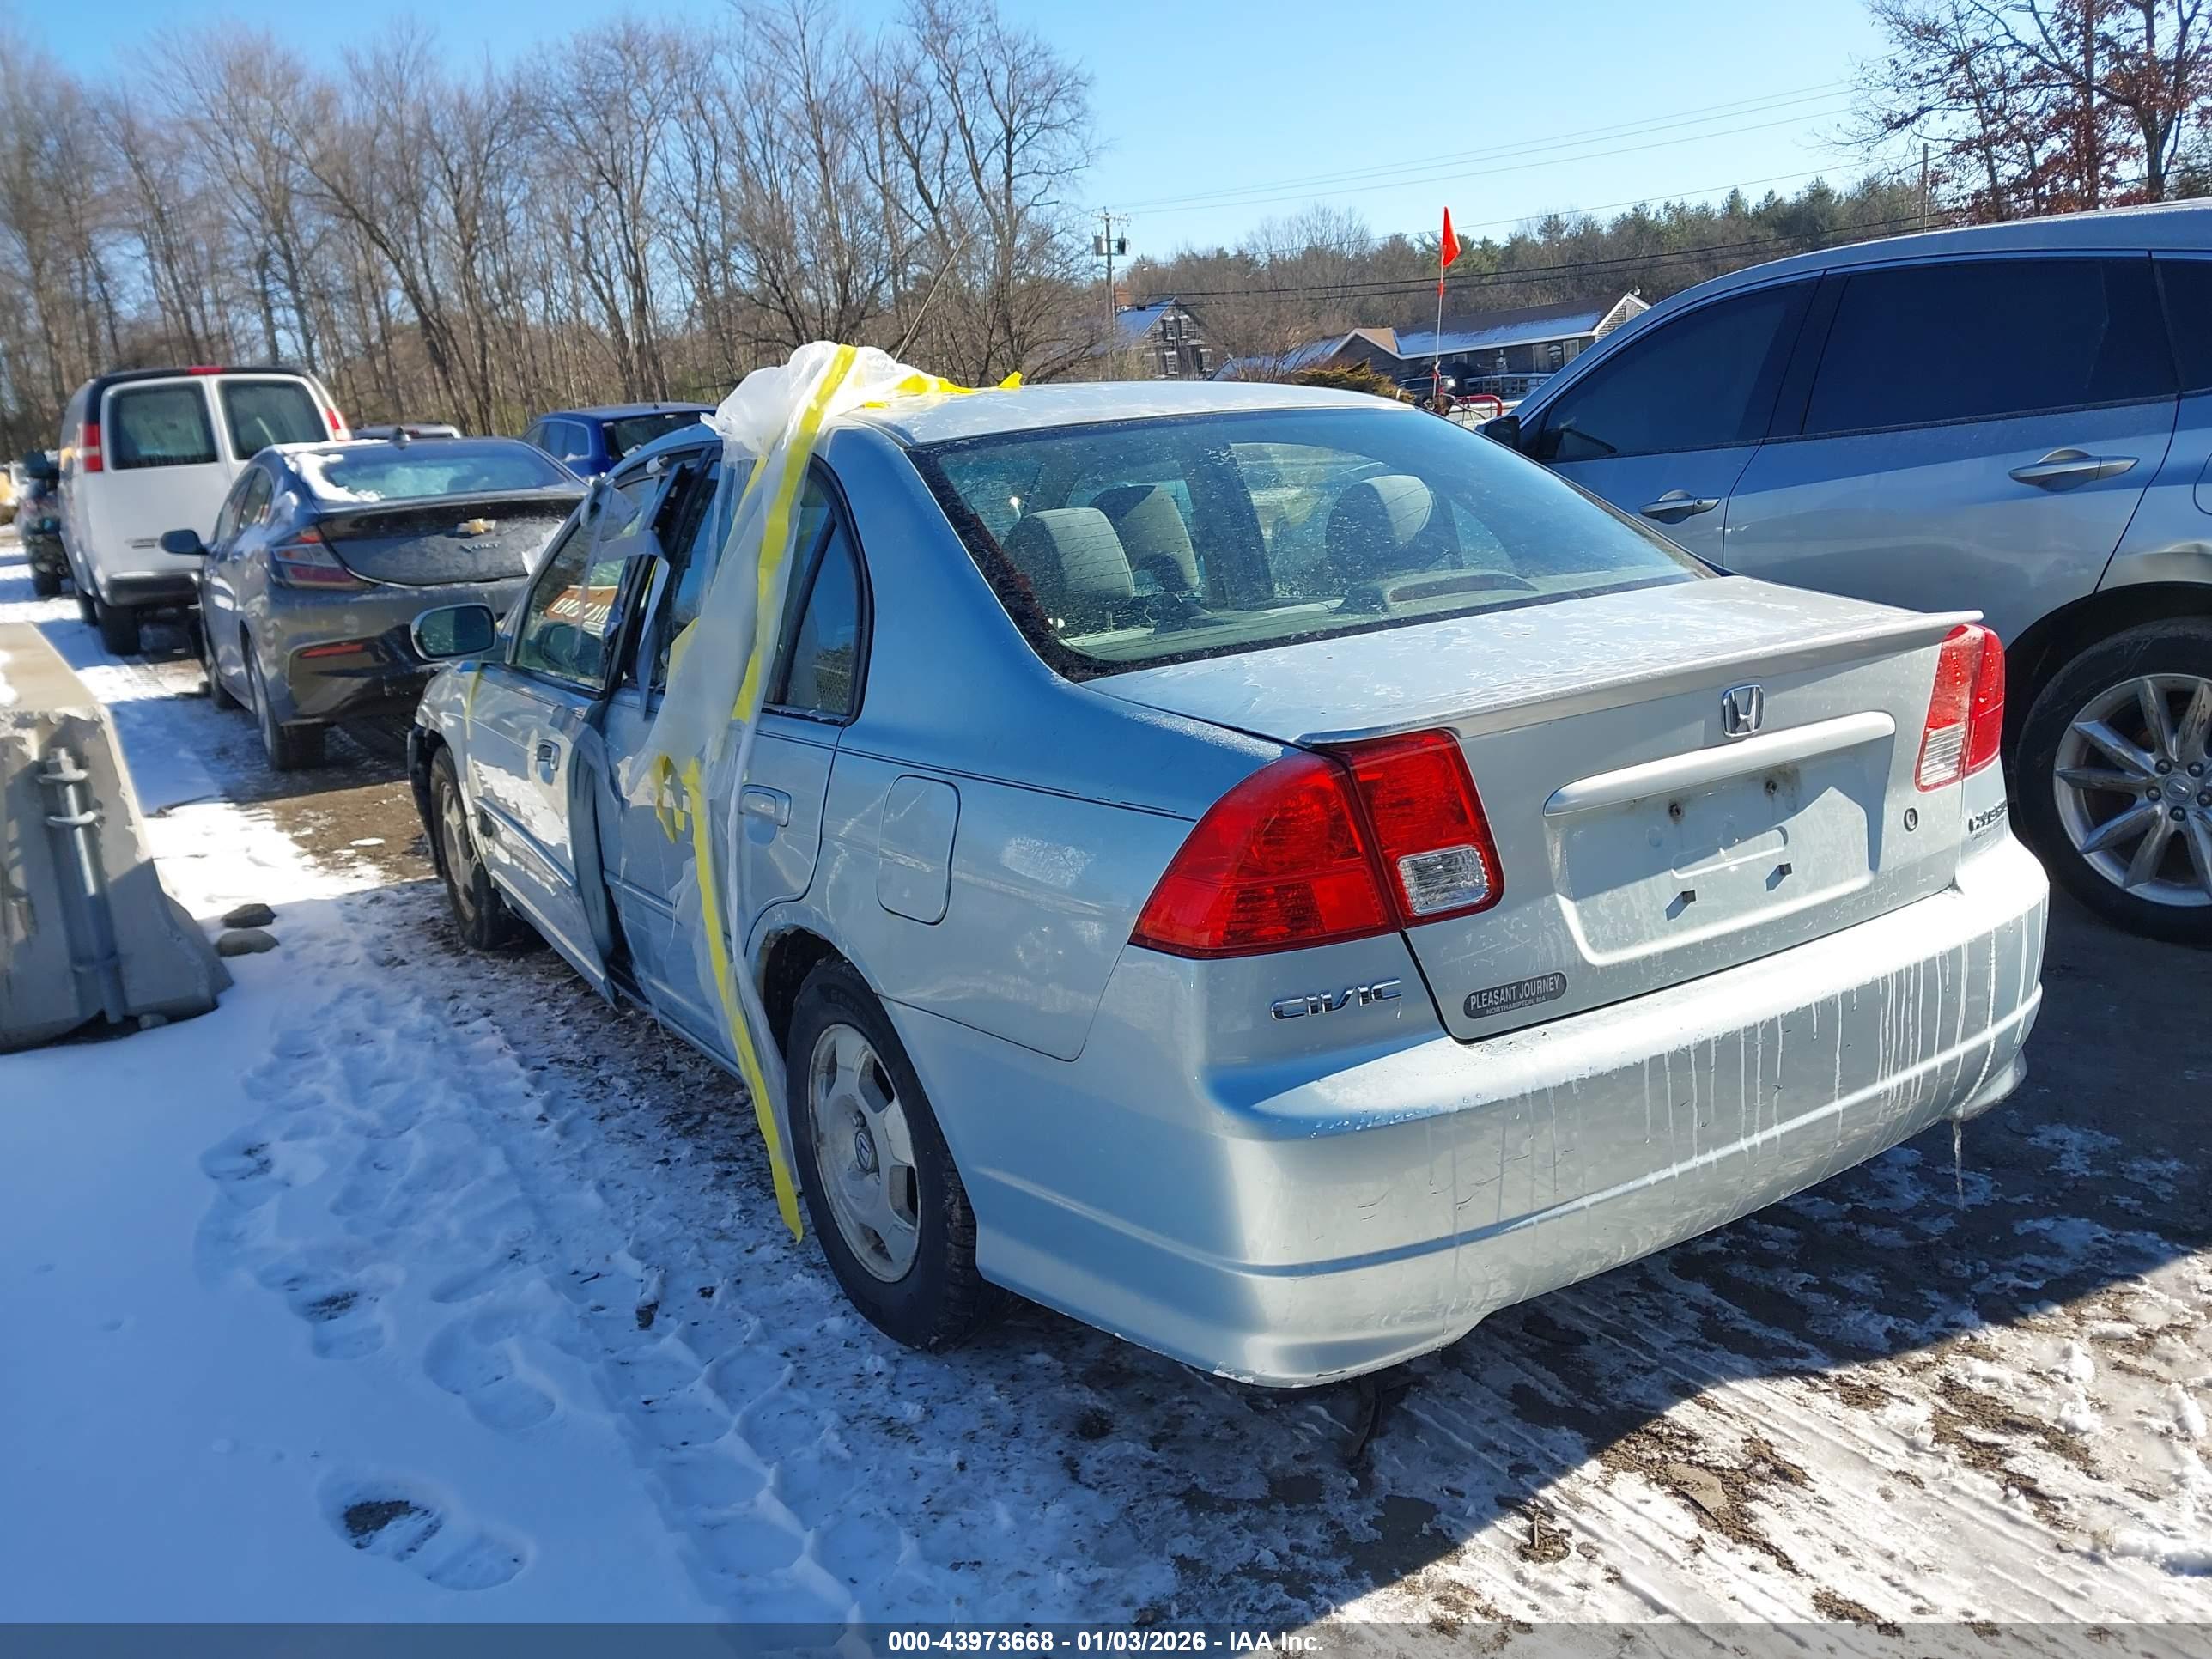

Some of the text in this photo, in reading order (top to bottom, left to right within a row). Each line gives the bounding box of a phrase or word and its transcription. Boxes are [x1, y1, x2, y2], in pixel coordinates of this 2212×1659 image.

[1271, 978, 1402, 1020] CIVIC
[1470, 975, 1560, 1011] PLEASANT JOURNEY
